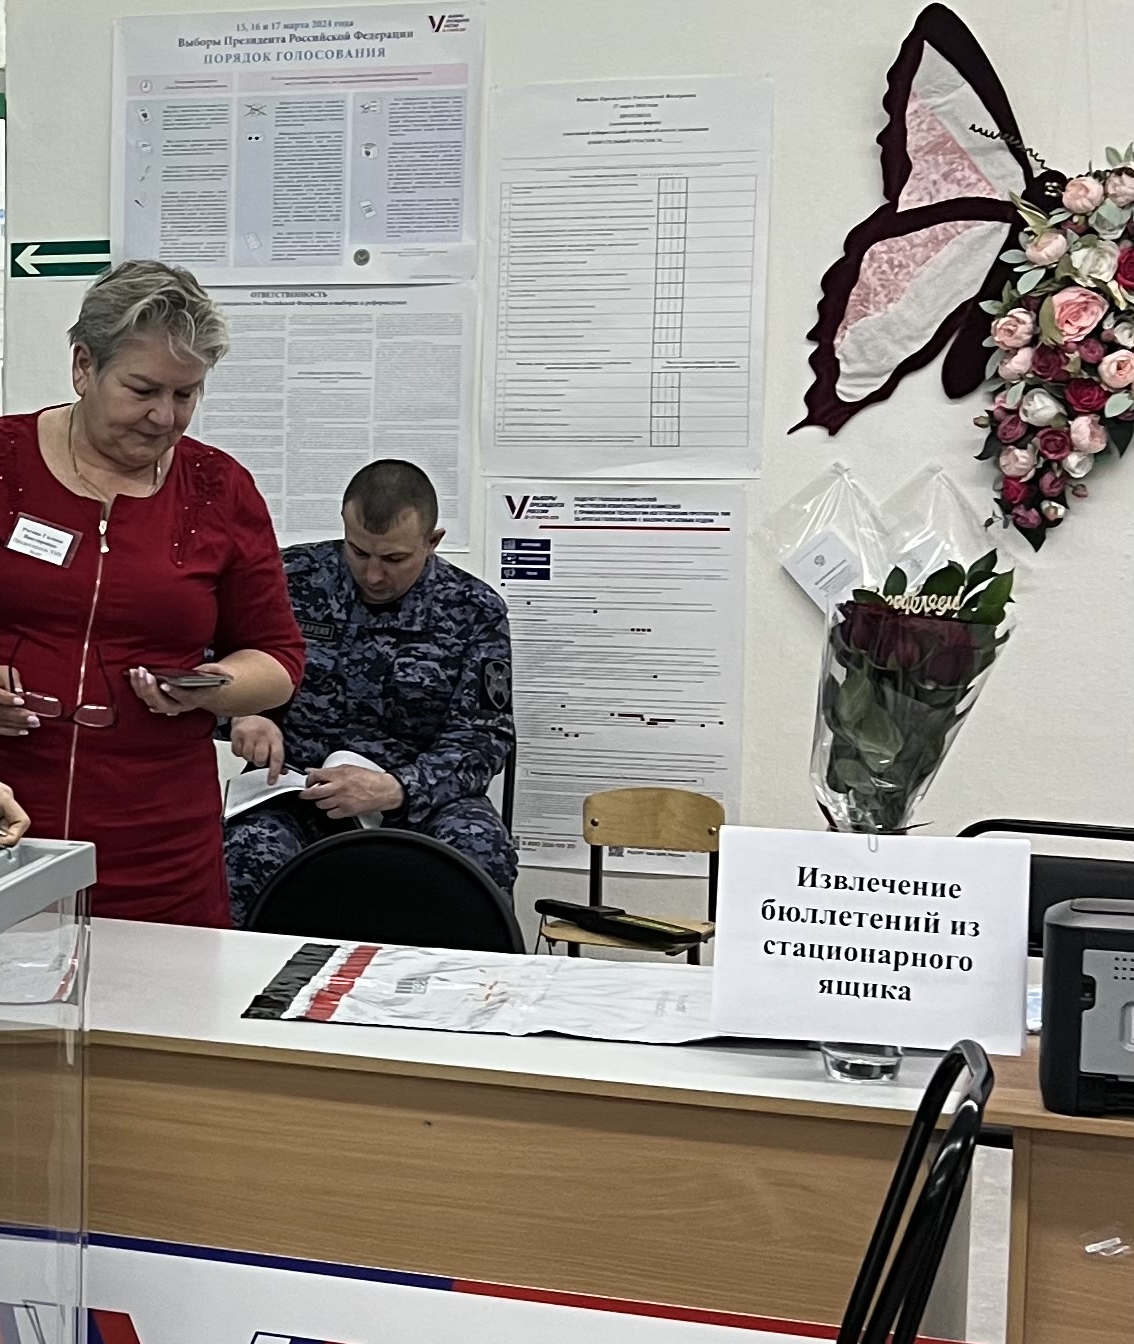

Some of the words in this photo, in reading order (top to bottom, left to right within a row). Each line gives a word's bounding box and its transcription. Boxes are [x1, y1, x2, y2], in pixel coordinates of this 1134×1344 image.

[178, 35, 221, 49] Выборы
[224, 35, 286, 48] Президента
[289, 32, 351, 43] Российской
[354, 29, 414, 42] Федерации
[204, 51, 271, 64] ПОРЯДОК
[276, 47, 386, 62] ГОЛОСОВАНИЯ
[797, 865, 962, 900] Извлечение
[761, 898, 941, 934] бюллетений
[950, 919, 981, 937] из
[763, 939, 973, 973] стационарного
[818, 978, 912, 1001] ящика
